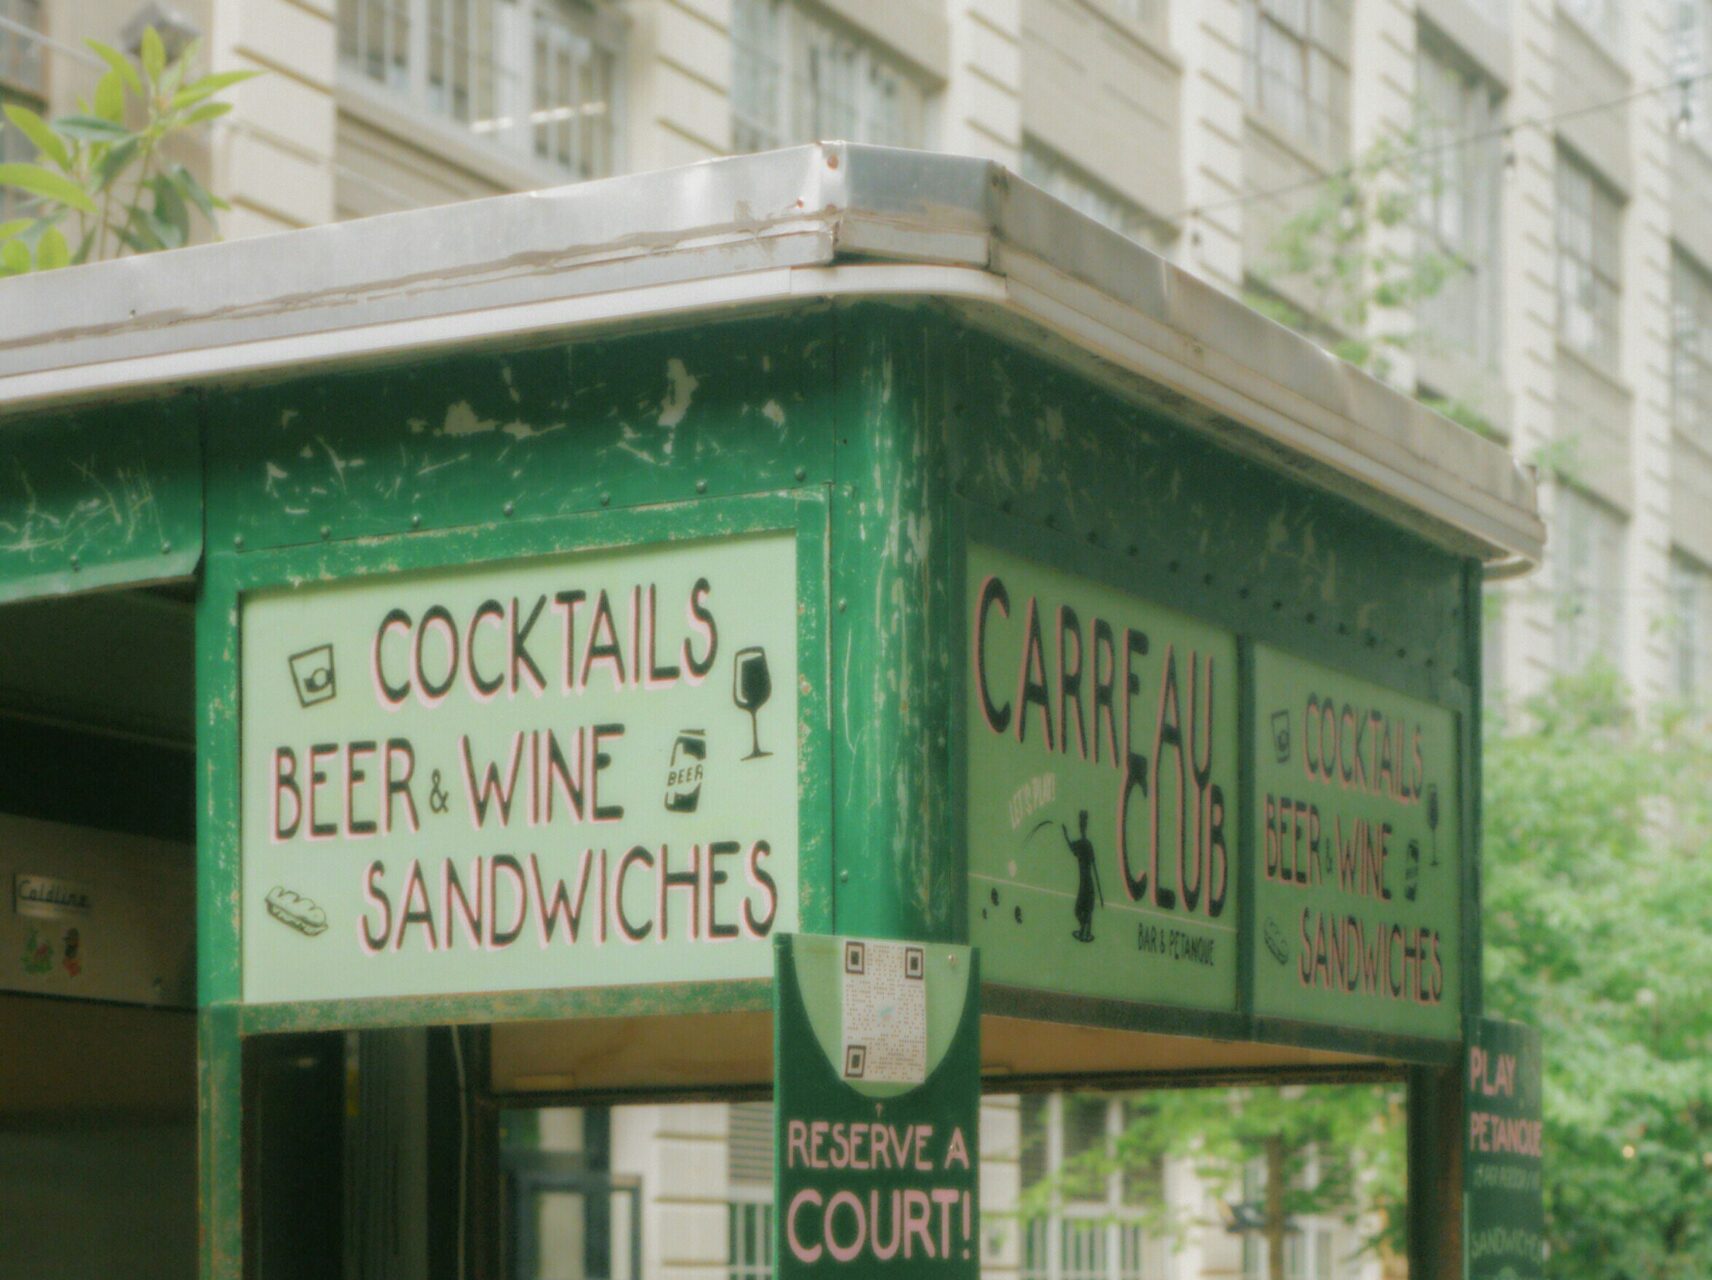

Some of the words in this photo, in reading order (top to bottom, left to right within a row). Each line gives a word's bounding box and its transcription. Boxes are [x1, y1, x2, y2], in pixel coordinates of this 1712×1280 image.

[372, 576, 718, 711] COCKTAILS
[973, 574, 1214, 790] CARREAU
[269, 736, 421, 845] BEER
[428, 768, 450, 814] &
[459, 722, 625, 829] WINE
[667, 763, 704, 787] BEER
[1304, 692, 1424, 805] COCKTAILS
[1116, 756, 1228, 918] CLUB
[1263, 793, 1322, 888] BEER
[1335, 812, 1393, 903] WINE
[356, 839, 778, 957] SANDWICHES
[1137, 921, 1157, 954] BAR
[1299, 907, 1443, 1005] SANDWICHES
[1470, 1046, 1516, 1097] PLAY
[788, 1119, 933, 1170] RESERVE
[945, 1126, 970, 1170] A
[787, 1188, 971, 1263] COURT!
